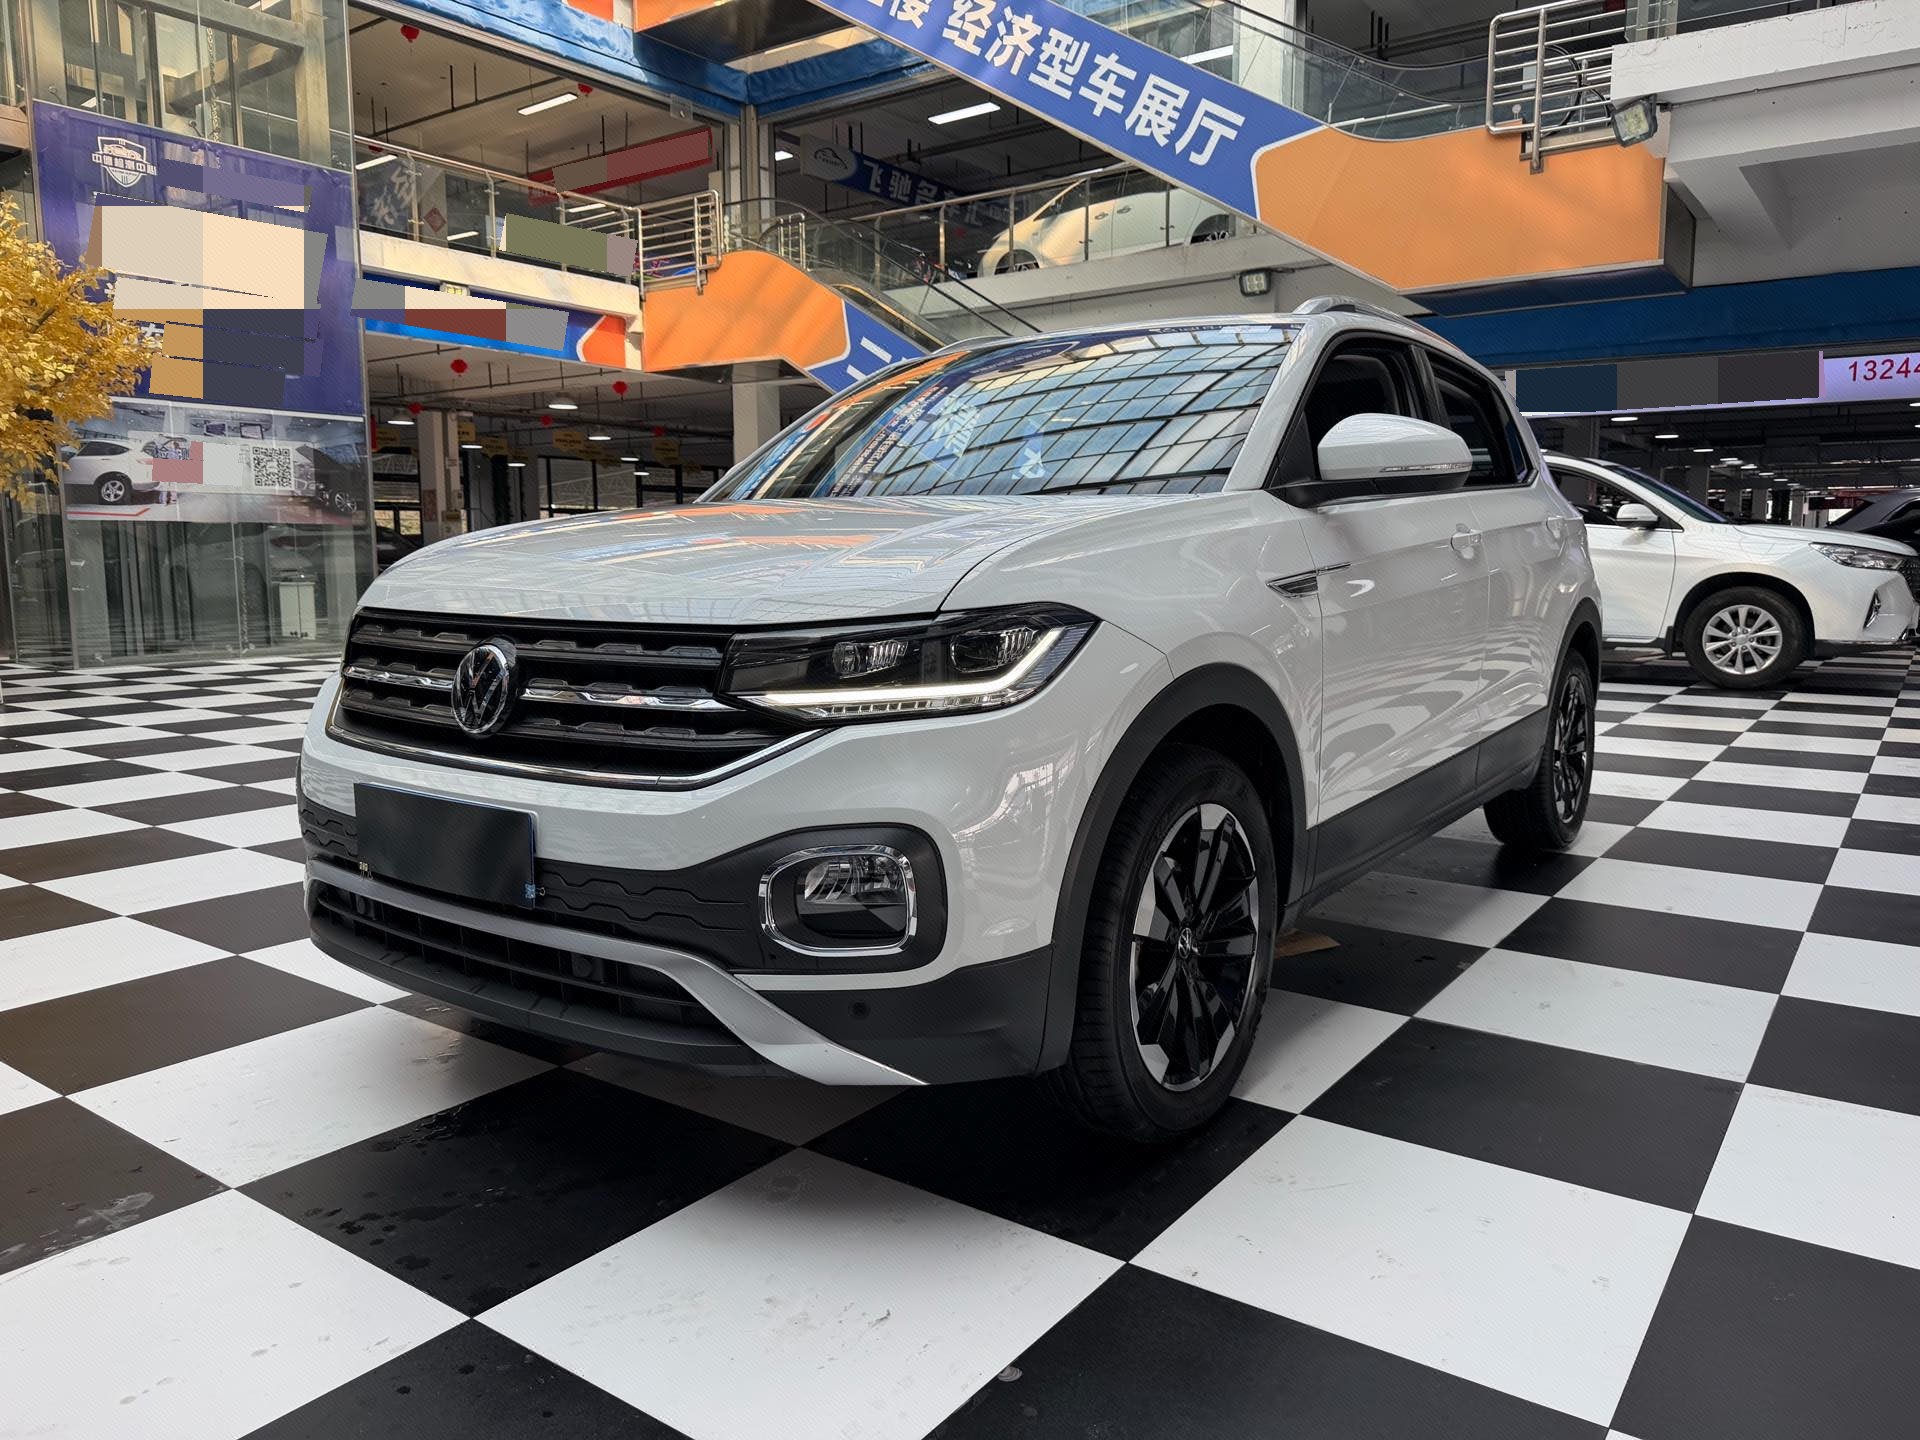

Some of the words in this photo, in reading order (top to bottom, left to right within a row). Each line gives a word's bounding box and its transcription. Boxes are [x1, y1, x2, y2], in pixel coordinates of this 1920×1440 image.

[942, 0, 1245, 166] 经济型车展厅
